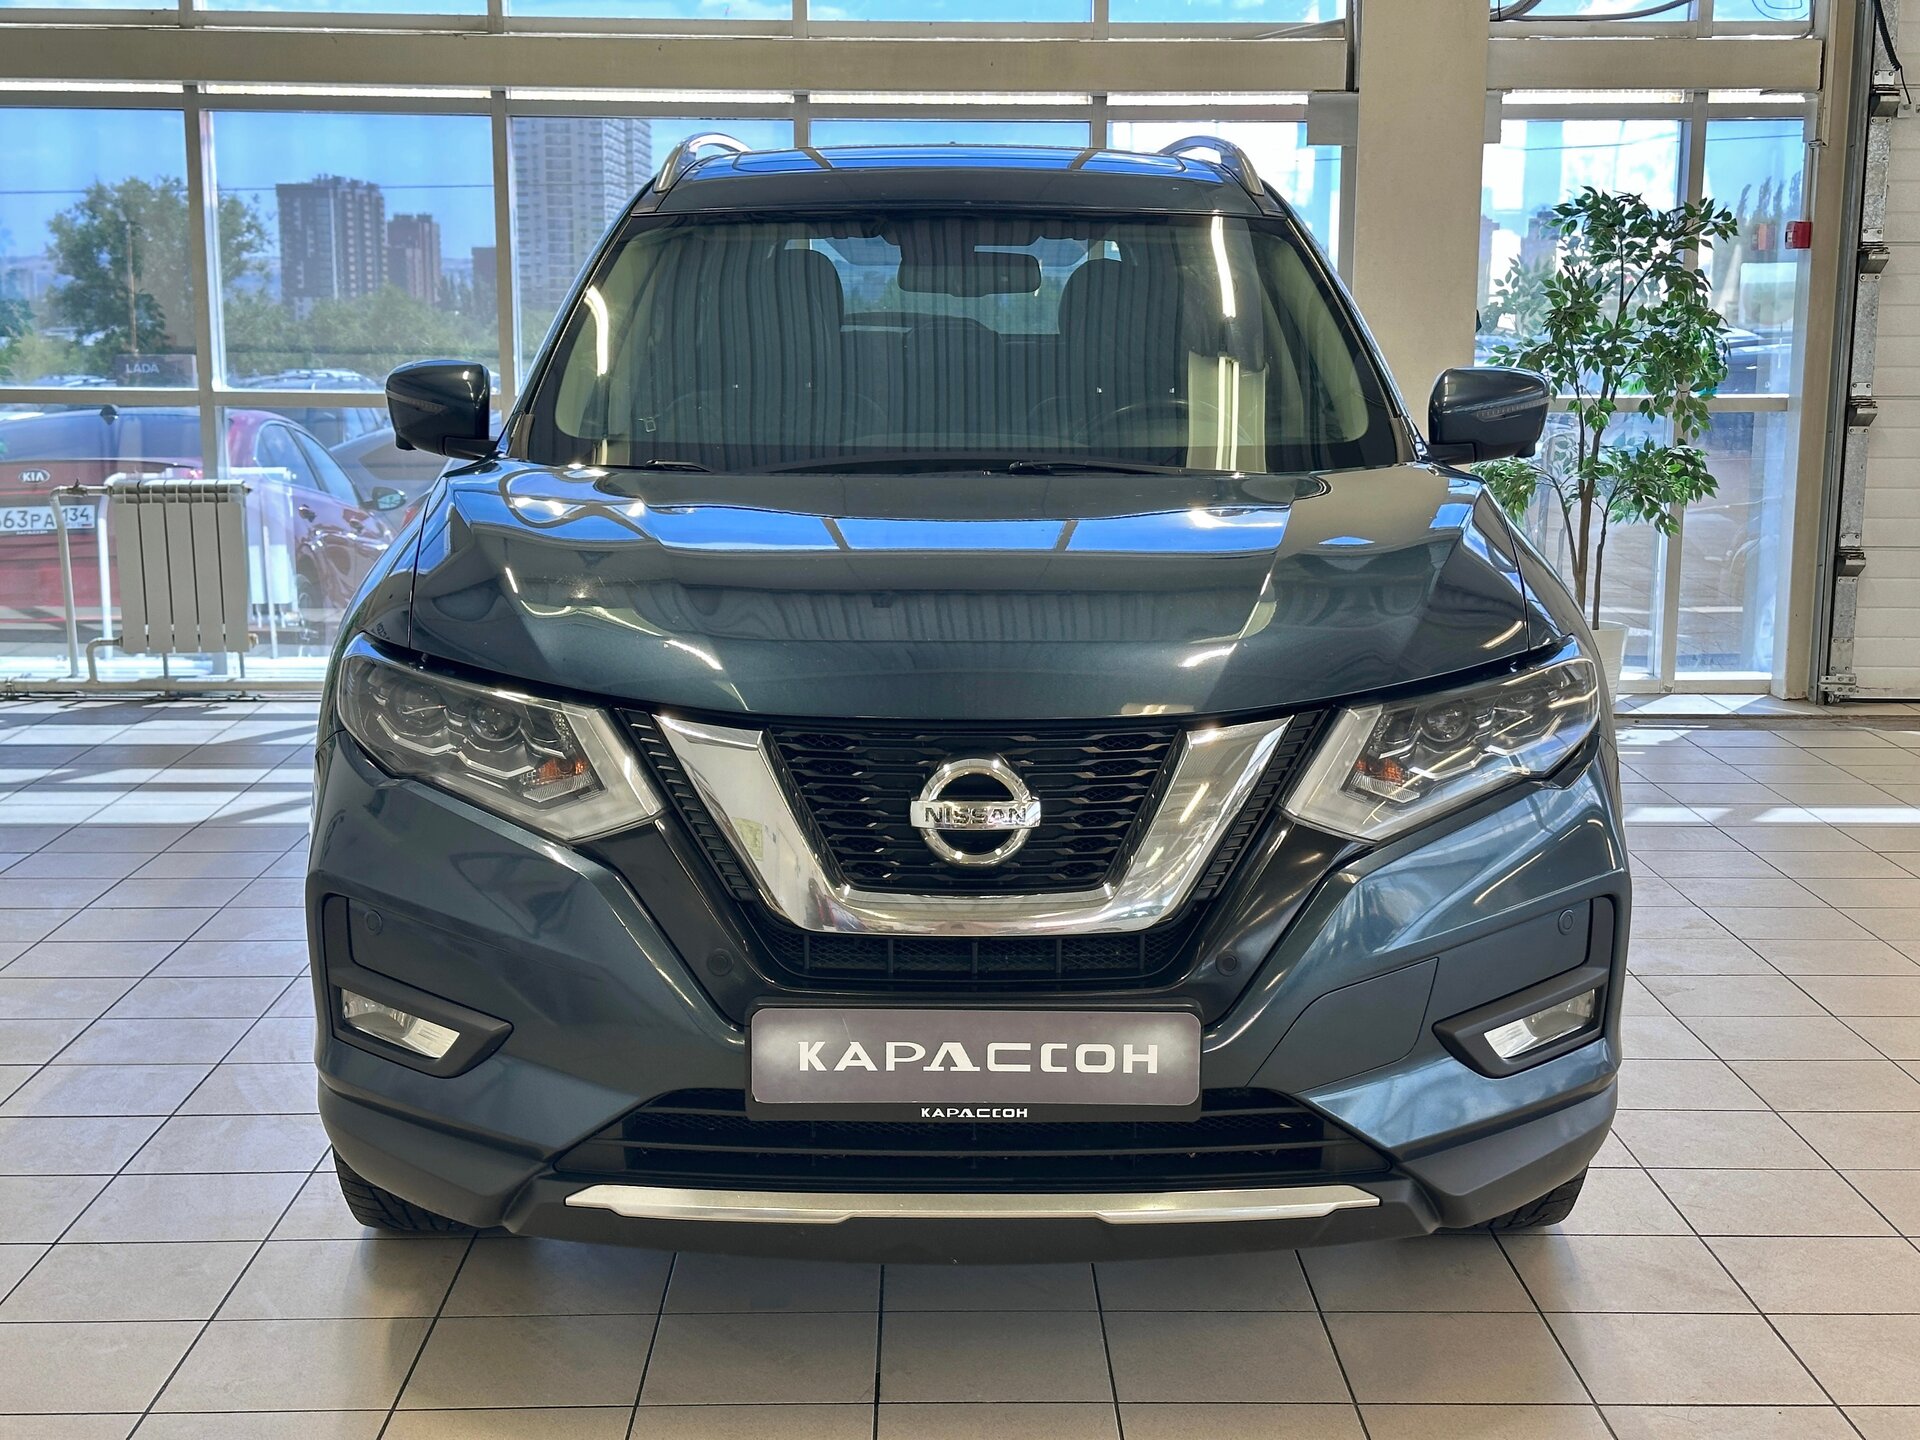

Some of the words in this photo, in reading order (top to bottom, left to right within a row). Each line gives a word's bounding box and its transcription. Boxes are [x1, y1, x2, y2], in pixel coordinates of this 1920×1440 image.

[125, 363, 160, 374] LADA
[22, 471, 45, 482] KIA
[0, 510, 55, 529] 63РА
[62, 507, 89, 522] 134
[924, 806, 1027, 824] NISSAN
